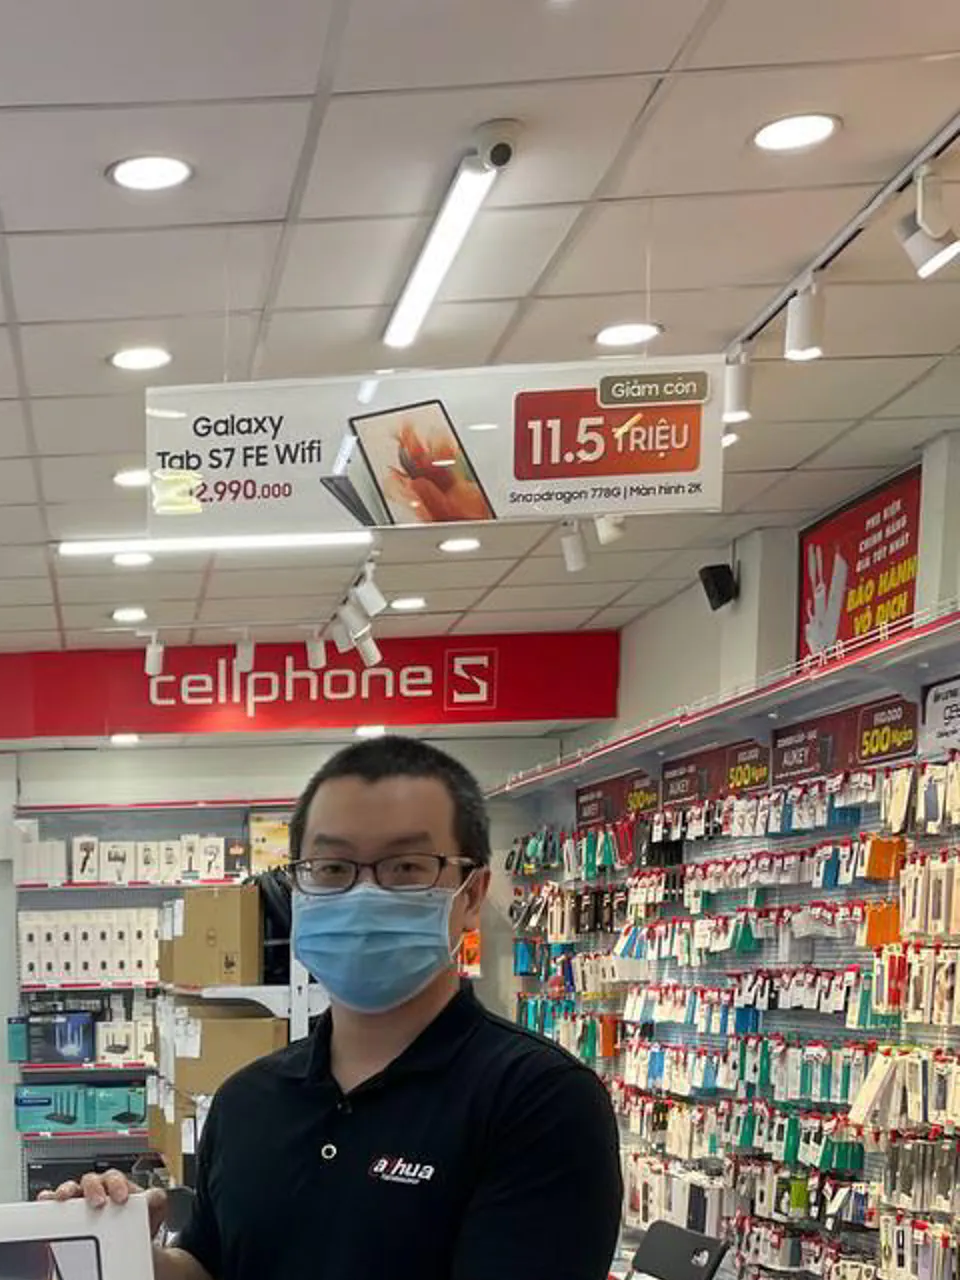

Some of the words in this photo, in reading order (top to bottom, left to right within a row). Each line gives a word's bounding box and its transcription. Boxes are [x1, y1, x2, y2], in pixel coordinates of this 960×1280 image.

[611, 379, 659, 398] Giảm
[193, 414, 284, 440] Galaxy
[527, 416, 605, 465] 11.5
[612, 417, 689, 458] TRIỆU
[156, 450, 202, 471] Tab
[208, 448, 235, 469] S7
[243, 445, 268, 467] FE
[275, 440, 322, 465] Wifi
[189, 479, 293, 503] 2.990.000
[509, 488, 588, 505] Snapdragon
